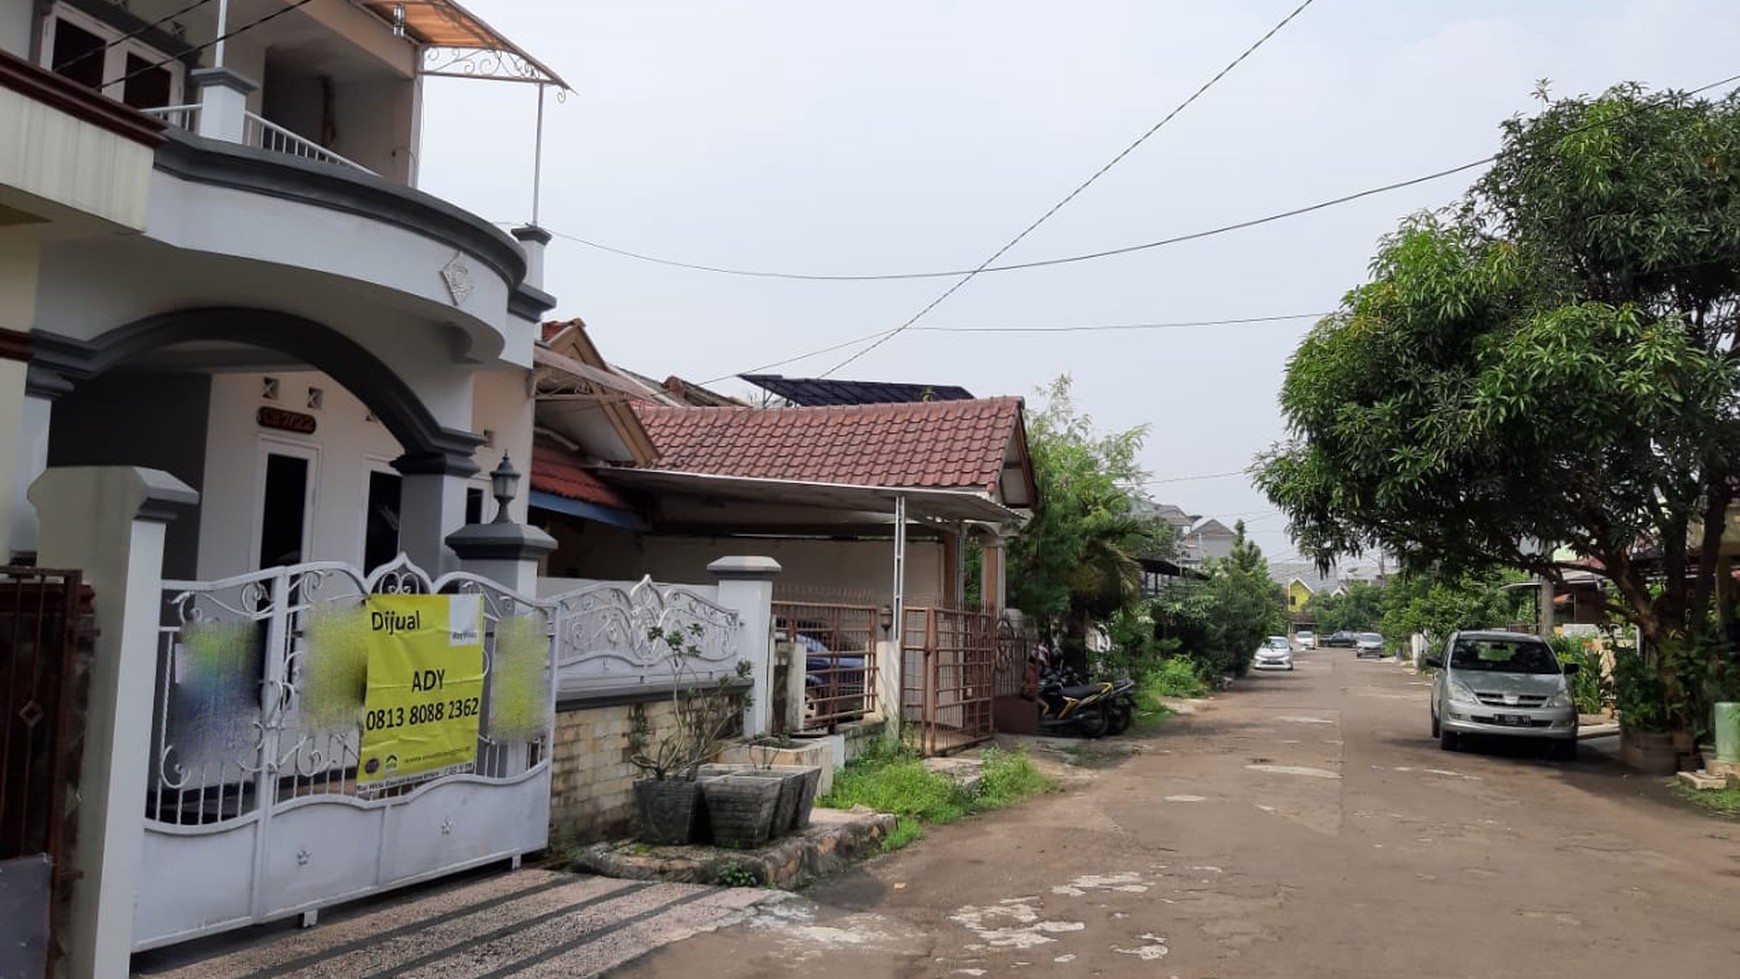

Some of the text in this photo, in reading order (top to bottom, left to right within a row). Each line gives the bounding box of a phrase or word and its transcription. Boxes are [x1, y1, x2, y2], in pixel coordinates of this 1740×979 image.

[371, 610, 420, 636] Dijual
[411, 669, 446, 693] ADY
[366, 697, 479, 731] 0813 8088 2362
